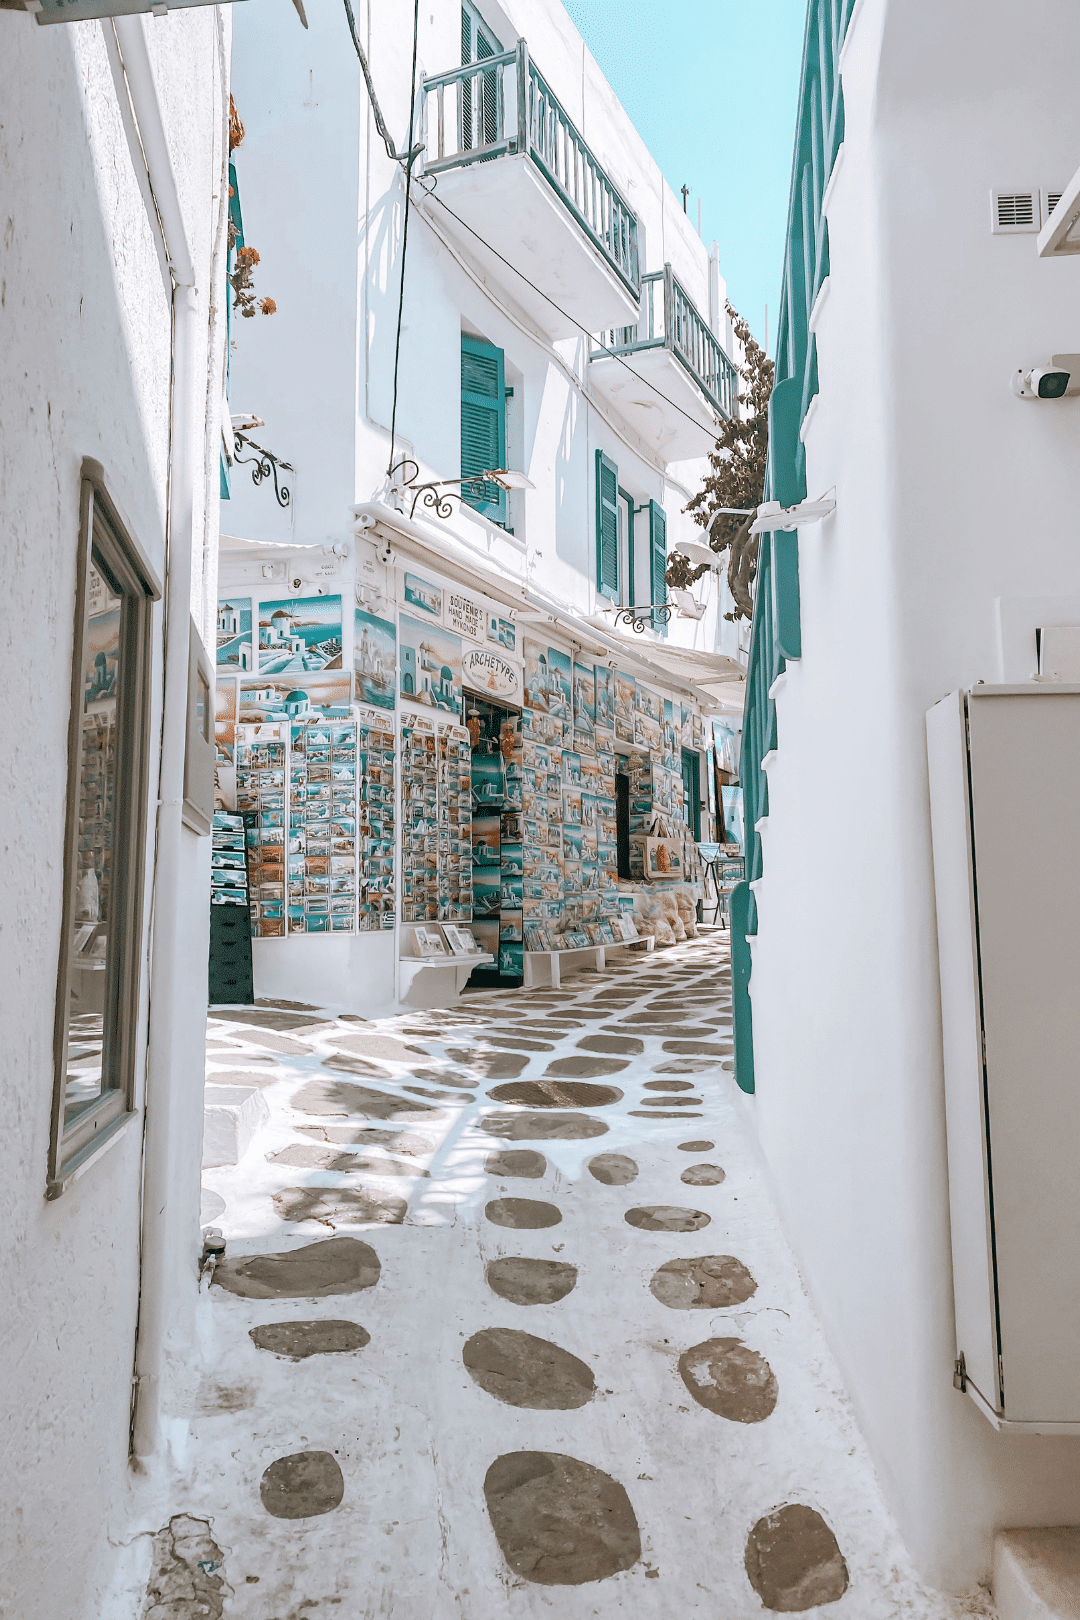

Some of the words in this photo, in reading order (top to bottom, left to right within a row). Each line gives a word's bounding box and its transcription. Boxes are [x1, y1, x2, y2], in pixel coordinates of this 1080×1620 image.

[448, 606, 462, 619] HAND
[465, 614, 478, 627] MADE
[450, 596, 483, 620] SOUVENIRS
[452, 618, 477, 636] MYKONOS
[470, 653, 515, 683] ARCHETYPE
